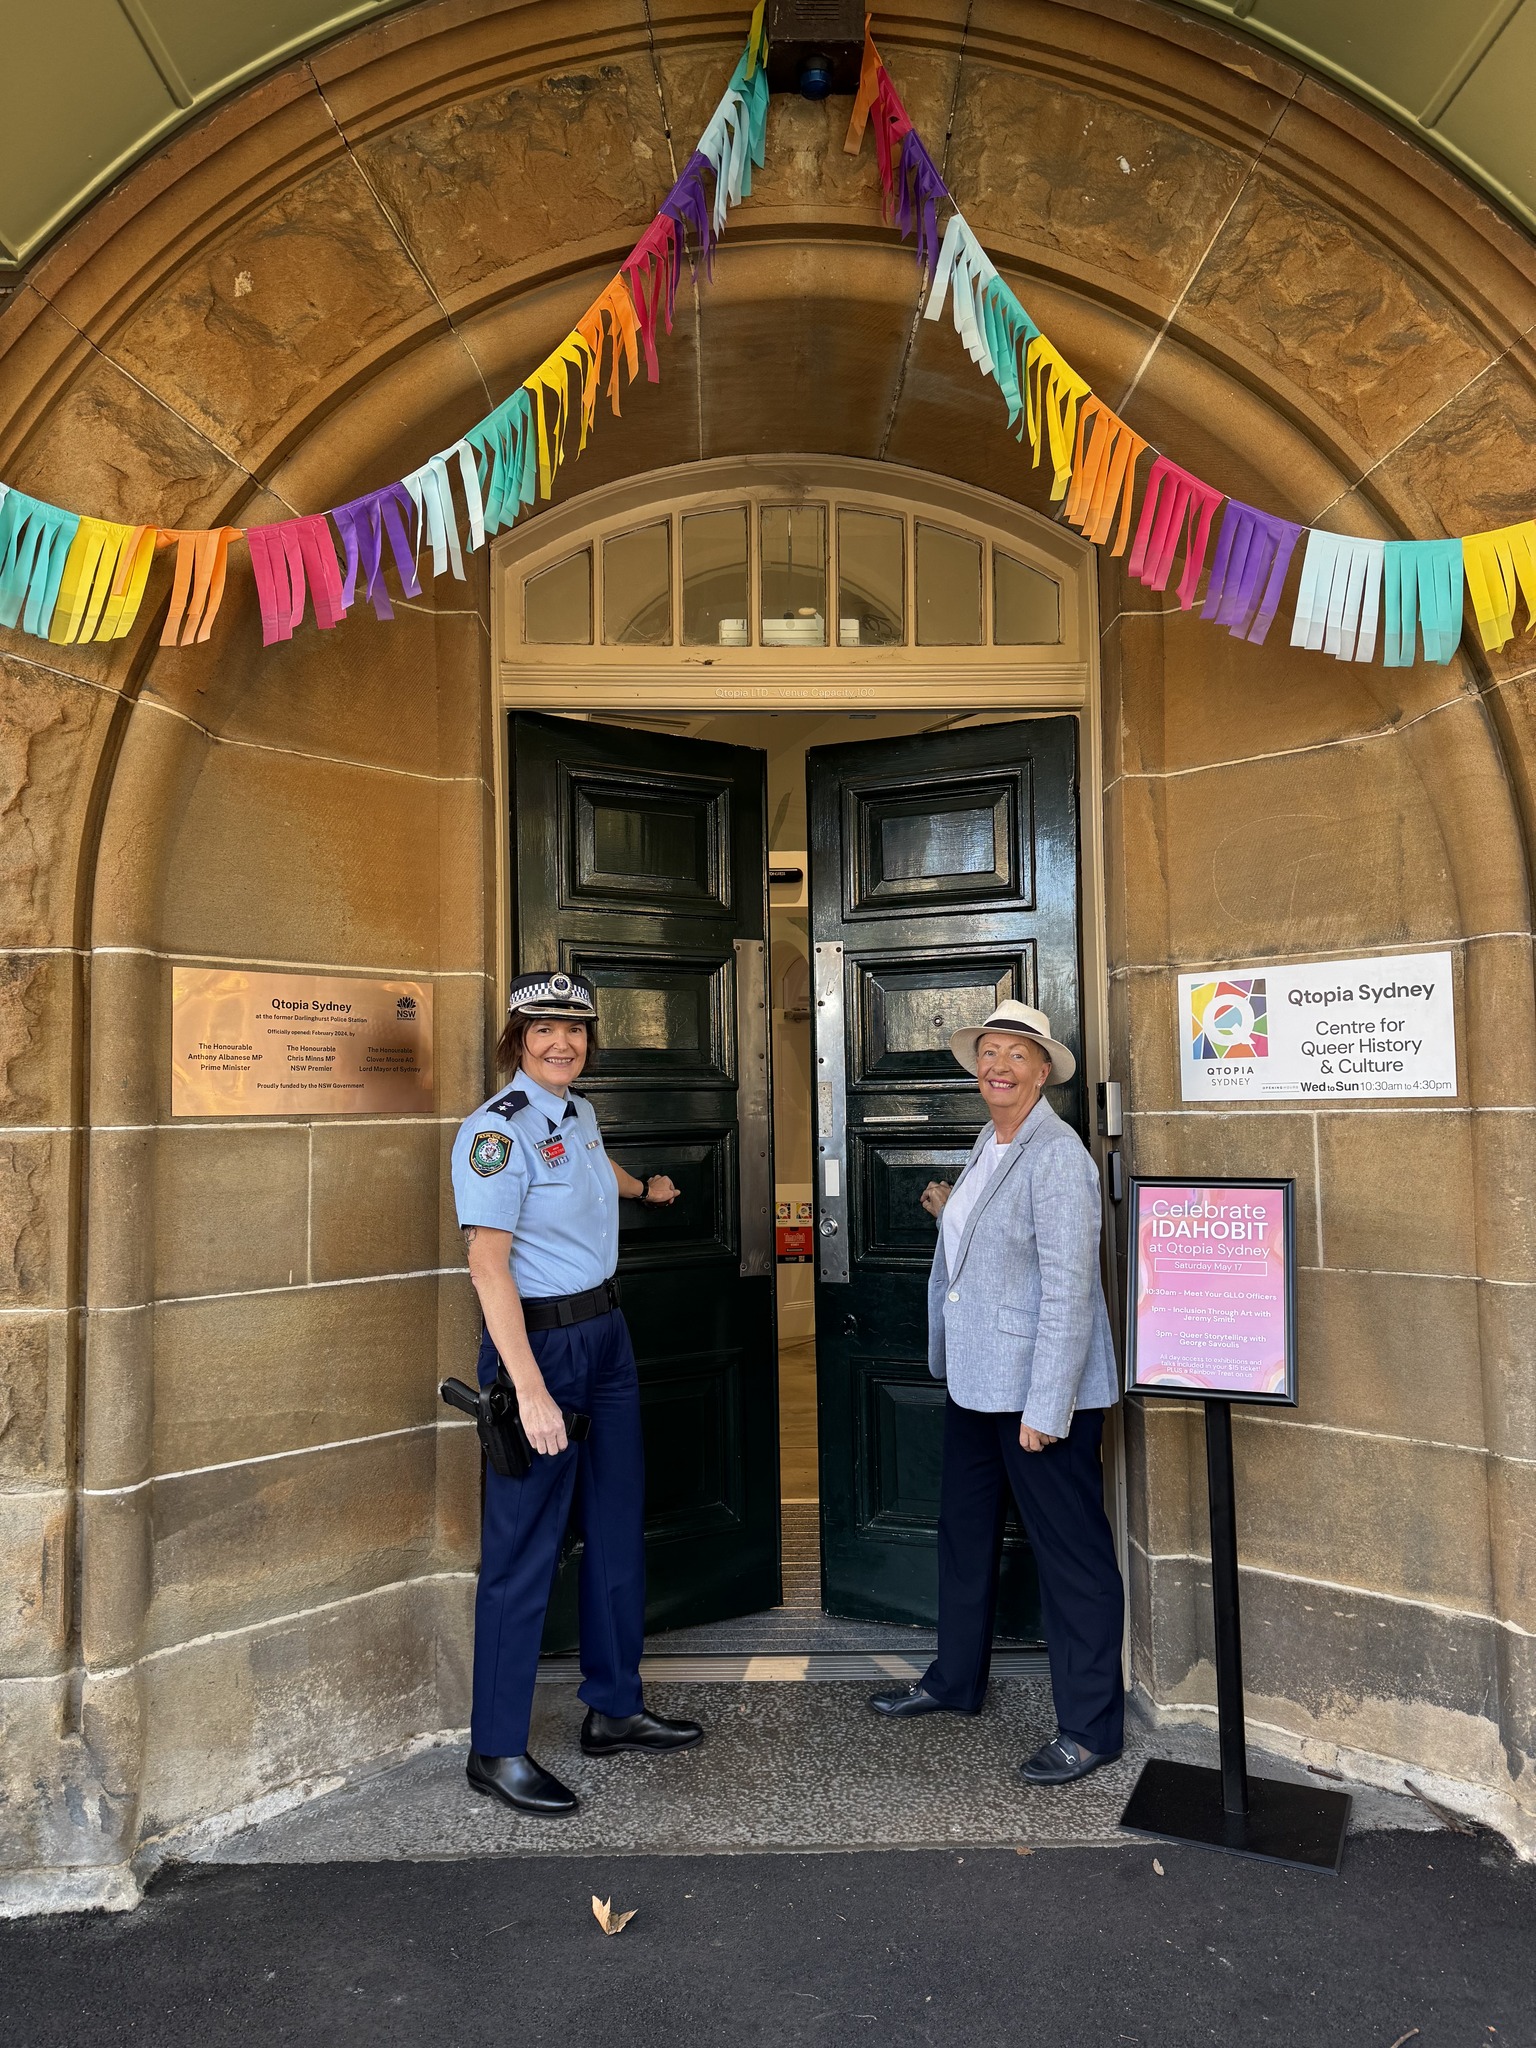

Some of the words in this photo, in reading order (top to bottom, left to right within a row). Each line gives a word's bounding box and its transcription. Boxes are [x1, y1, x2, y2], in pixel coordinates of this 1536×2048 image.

[716, 688, 748, 699] Qtopia
[752, 688, 768, 697] LTD
[779, 688, 808, 697] Venue
[811, 688, 854, 699] Capacity
[858, 688, 874, 697] 100
[1288, 986, 1354, 1006] Qtopia
[1359, 982, 1435, 1002] Sydney
[272, 998, 308, 1011] Qtopia
[312, 1000, 352, 1013] Sydney
[396, 1010, 416, 1018] NSW
[1316, 1020, 1376, 1036] Centre
[1380, 1018, 1406, 1033] for
[1301, 1040, 1355, 1058] Queer
[1359, 1037, 1422, 1054] History
[1207, 1066, 1254, 1076] QTOPIA
[1320, 1060, 1334, 1074] &
[1338, 1058, 1404, 1074] Culture
[1212, 1078, 1250, 1086] SYDNEY
[1300, 1082, 1326, 1092] Wed
[1336, 1081, 1359, 1092] Sun
[1360, 1082, 1402, 1091] 10:30am
[1412, 1080, 1452, 1091] 4:30pm
[1152, 1200, 1266, 1220] Celebrate
[1152, 1220, 1268, 1240] IDAHOBIT
[1149, 1242, 1162, 1253] at
[1166, 1242, 1213, 1256] Qtopia
[1217, 1243, 1270, 1259] Sydney
[1174, 1262, 1212, 1271] Saturday
[1214, 1262, 1232, 1272] May
[1146, 1288, 1176, 1296] 10:30am
[1246, 1292, 1277, 1300] Officers
[1208, 1308, 1239, 1317] Through
[1183, 1315, 1212, 1323] Jeremy
[1155, 1330, 1172, 1338] 3pm
[1204, 1332, 1248, 1343] Storytelling
[1179, 1339, 1207, 1347] George
[1208, 1340, 1240, 1348] Savoulis
